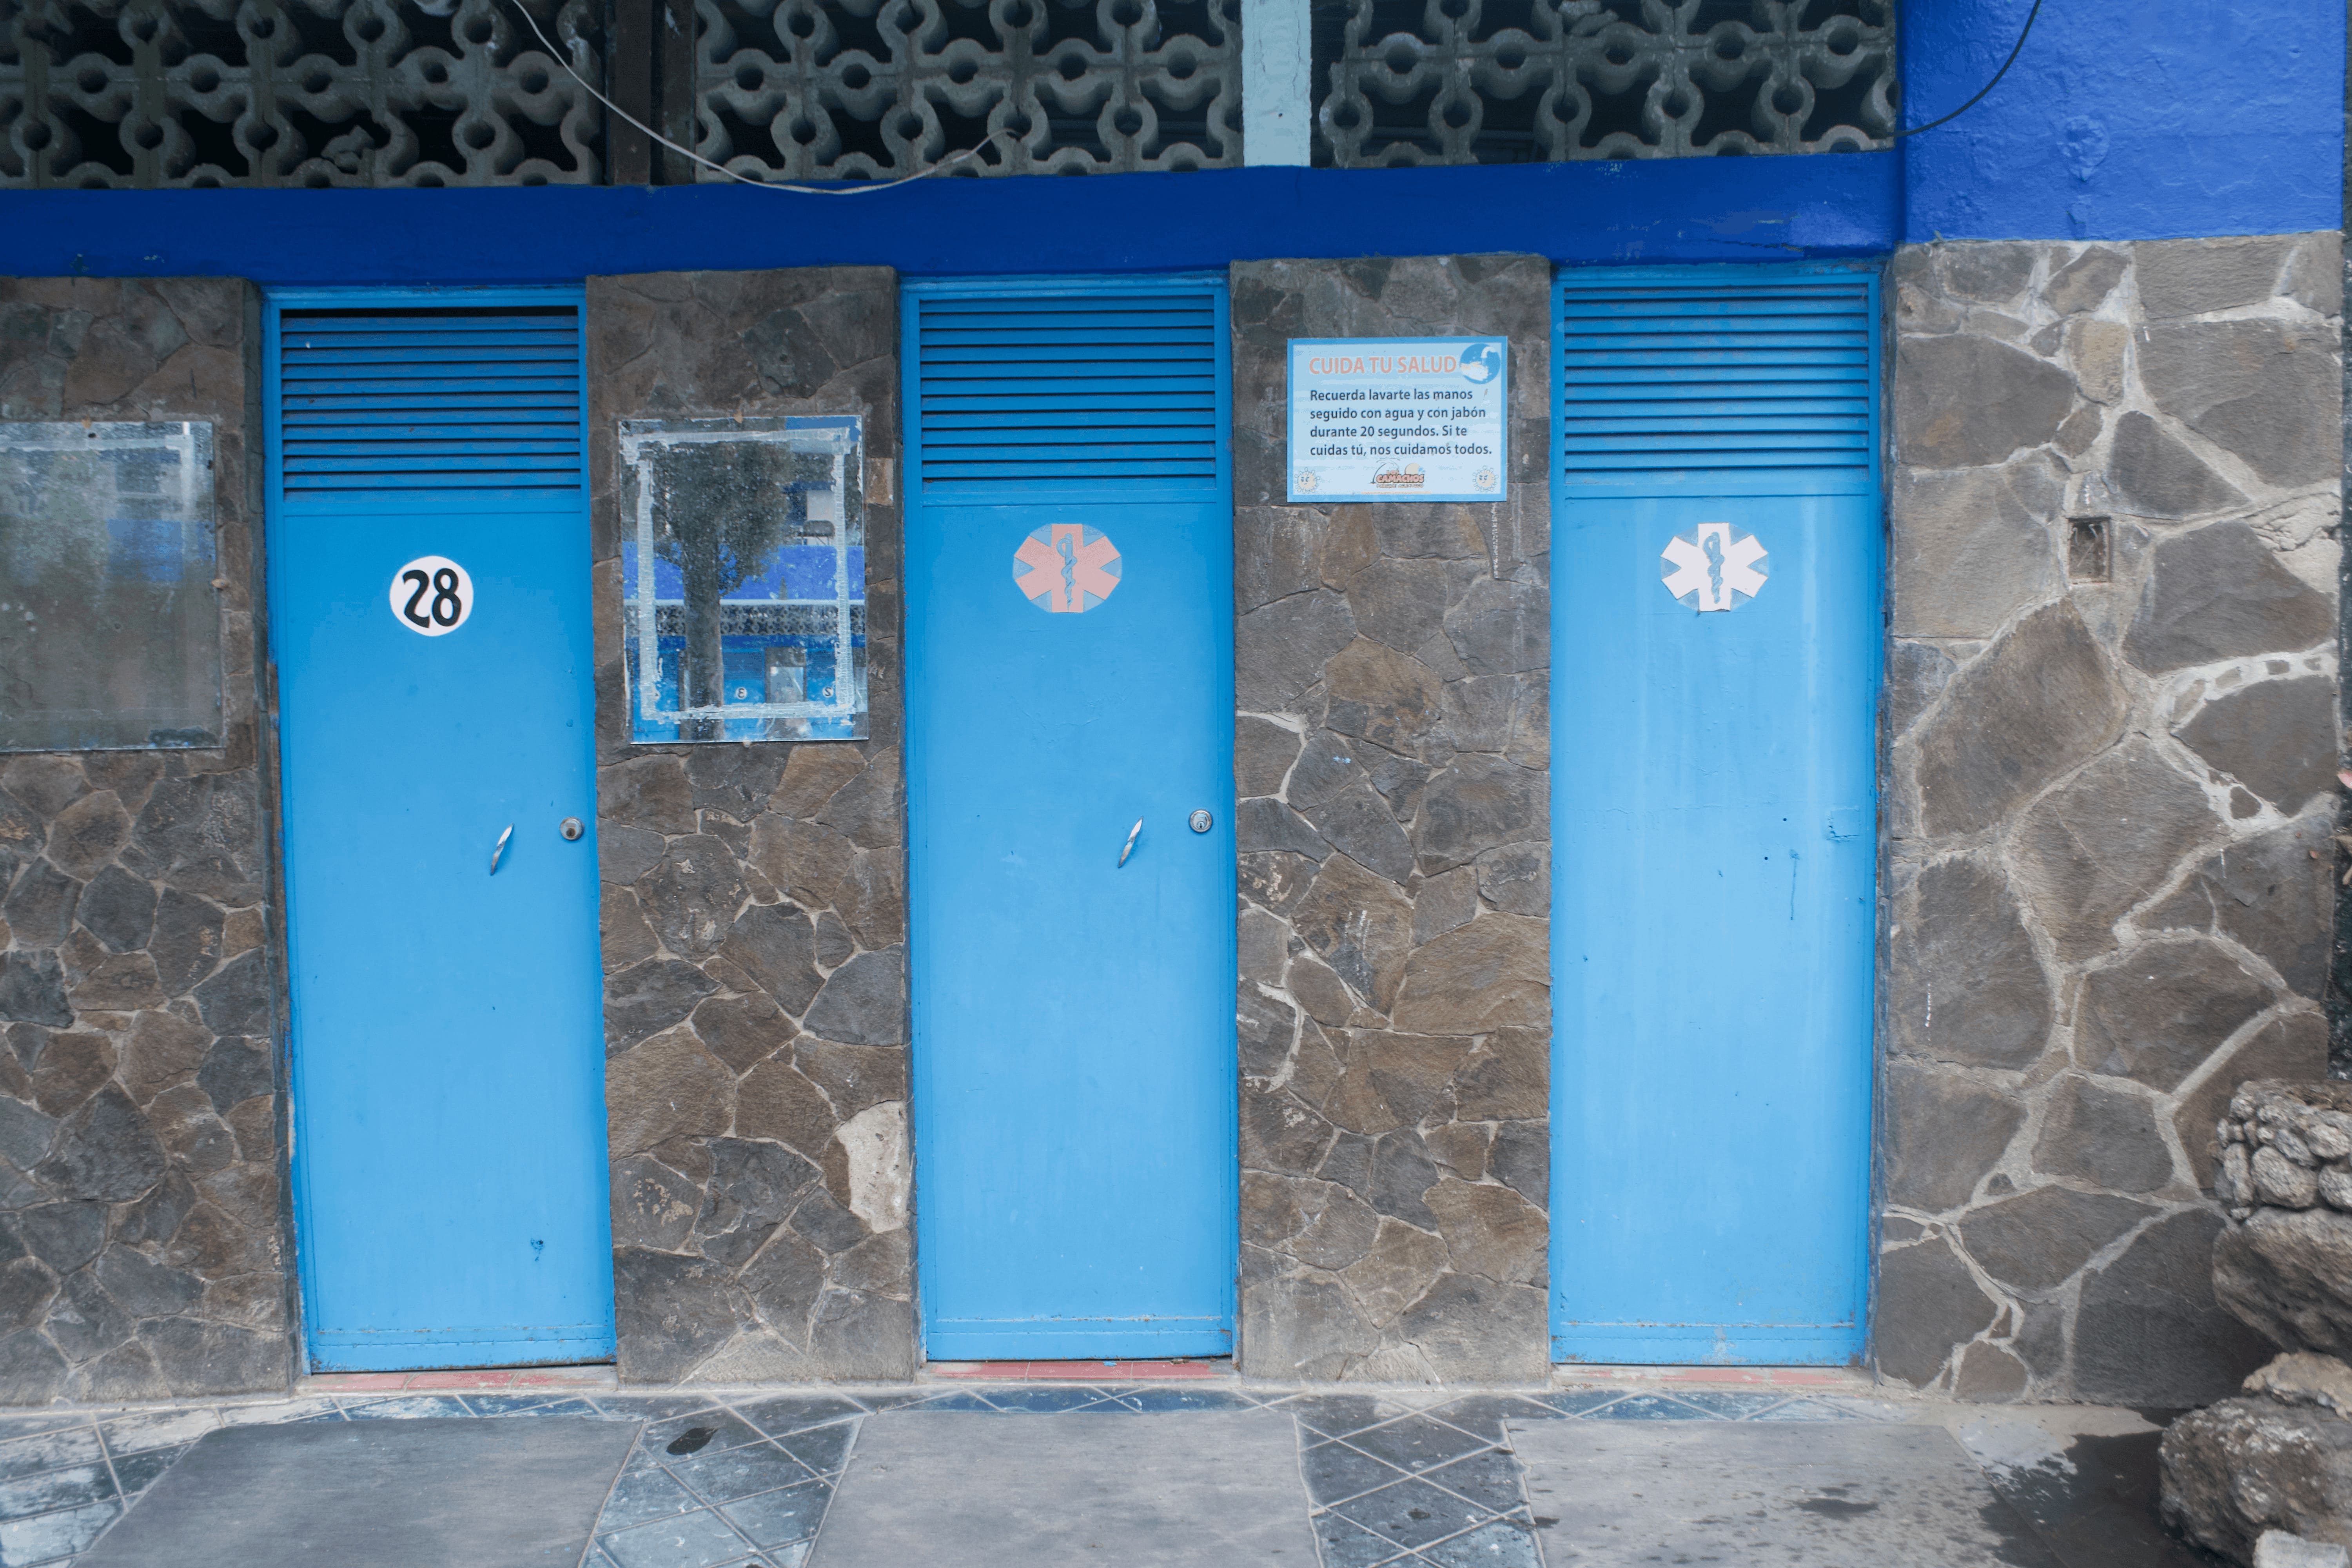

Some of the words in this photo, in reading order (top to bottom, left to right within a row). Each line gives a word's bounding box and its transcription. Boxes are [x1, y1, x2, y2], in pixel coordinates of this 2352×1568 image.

[1310, 357, 1365, 374] CUIDA
[1369, 357, 1392, 374] TU
[1398, 356, 1456, 373] SALUD
[1310, 390, 1365, 401] Recuerda
[1369, 389, 1410, 400] lavarte
[1414, 389, 1430, 400] las
[1433, 390, 1472, 399] manos
[1310, 408, 1357, 421] seguido
[1361, 409, 1381, 418] con
[1385, 409, 1413, 421] agua
[1417, 409, 1424, 421] y
[1428, 408, 1447, 418] con
[1451, 407, 1486, 420] jabón
[1310, 426, 1357, 437] durante
[1360, 426, 1374, 437] 20
[1378, 426, 1439, 439] segundos.
[1442, 425, 1452, 436] Si
[1456, 426, 1467, 436] te
[1310, 444, 1347, 456] cuidas
[1351, 444, 1366, 456] tú,
[1370, 446, 1390, 456] nos
[1394, 444, 1451, 456] cuidamos
[1455, 444, 1492, 454] todos.
[1376, 474, 1424, 483] CAMACHOS
[403, 568, 461, 628] 28
